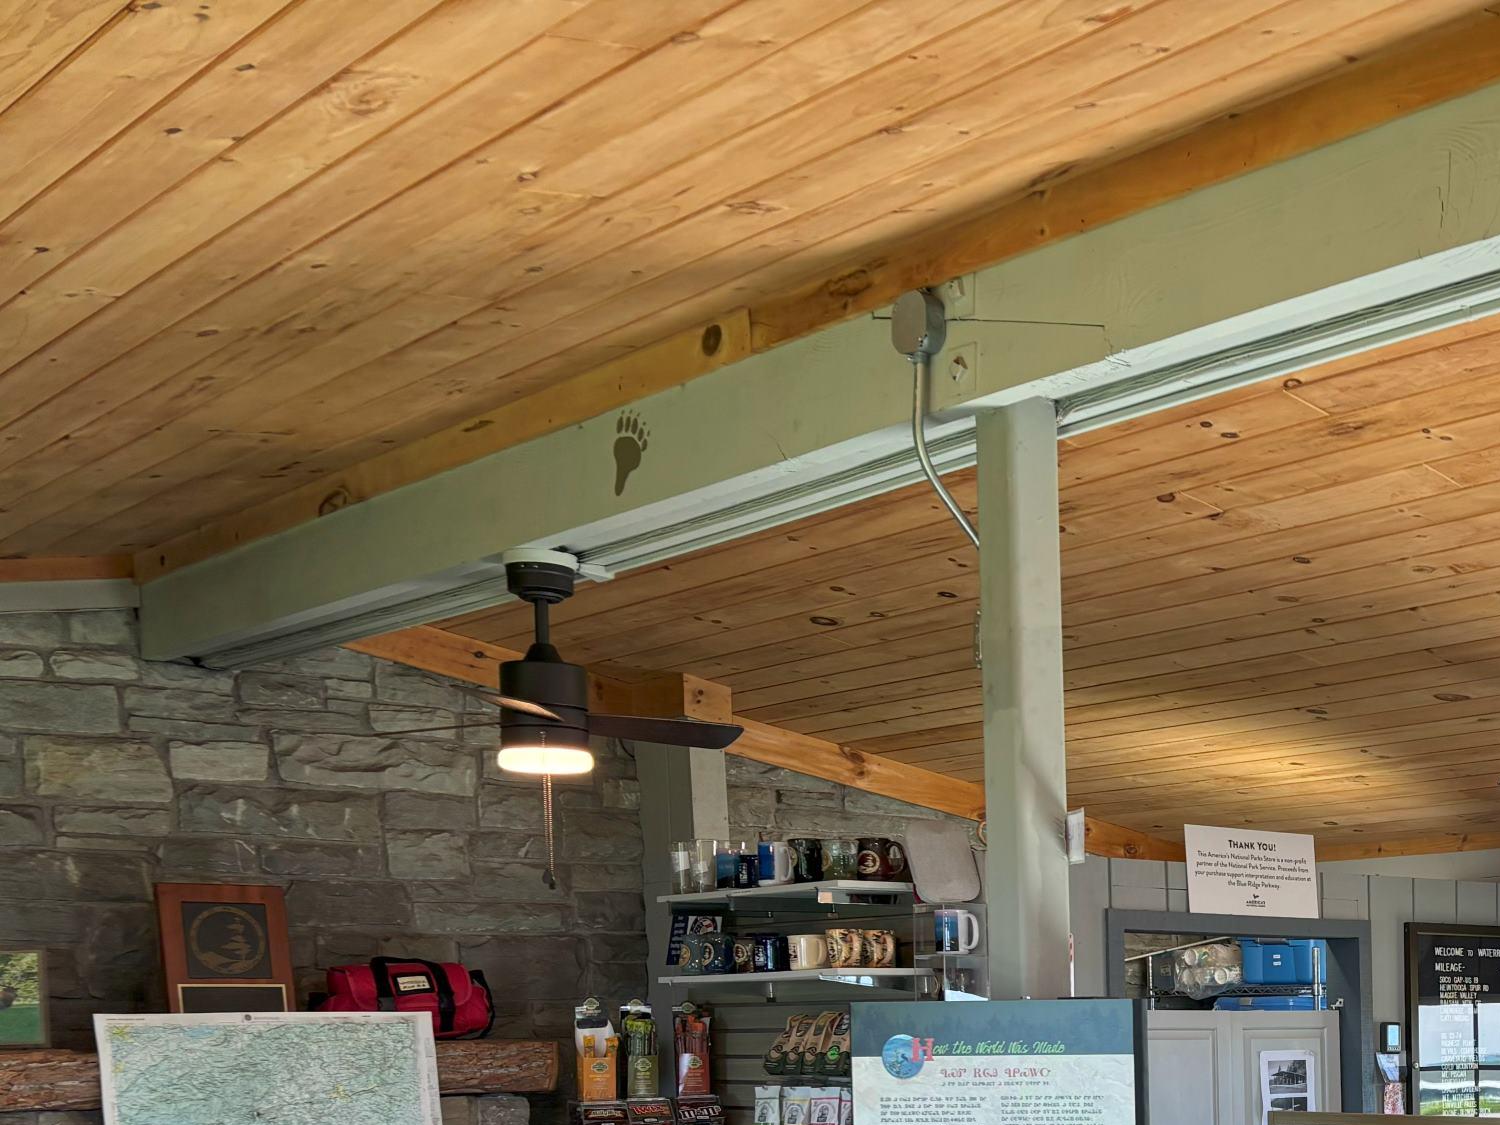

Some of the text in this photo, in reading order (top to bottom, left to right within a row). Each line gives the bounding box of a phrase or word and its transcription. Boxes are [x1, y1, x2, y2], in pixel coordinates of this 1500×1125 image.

[1228, 840, 1276, 851] THANK YOU!
[1229, 861, 1247, 869] National
[1248, 881, 1260, 889] Ridge
[1434, 947, 1464, 956] WELCOME
[952, 1041, 972, 1054] the
[975, 1040, 1006, 1054] World
[1008, 1040, 1028, 1054] Was
[1033, 1041, 1065, 1054] Made
